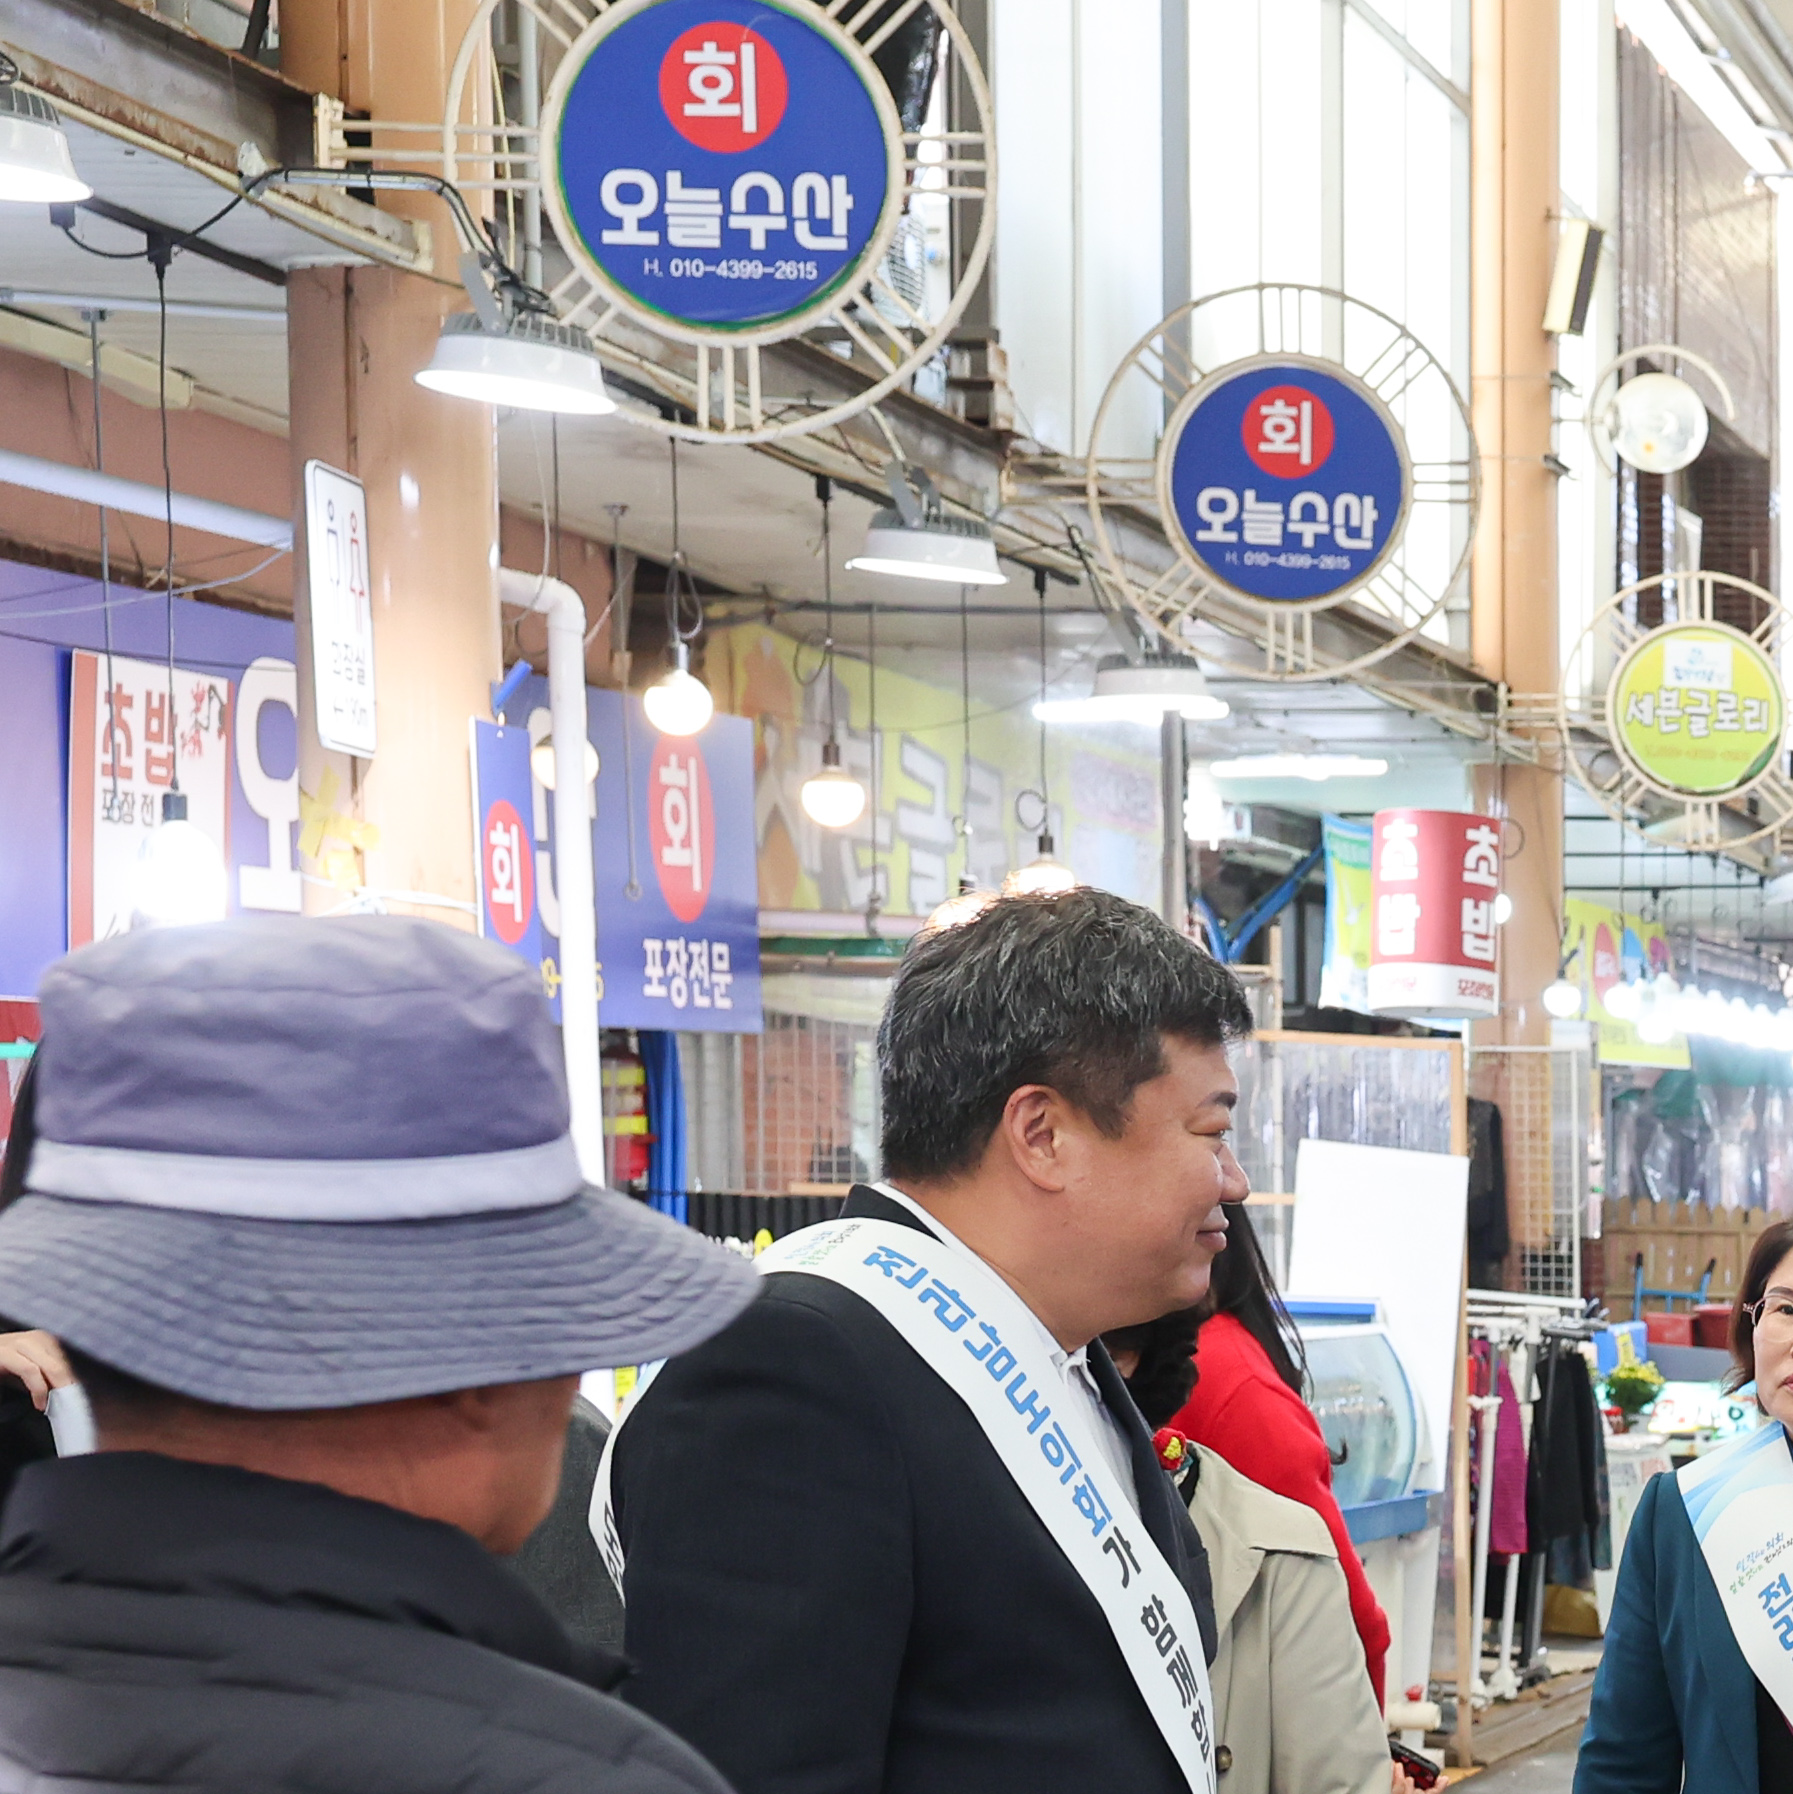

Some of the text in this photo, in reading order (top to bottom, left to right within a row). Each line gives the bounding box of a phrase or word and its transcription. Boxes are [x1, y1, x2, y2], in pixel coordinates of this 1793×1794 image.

[684, 41, 758, 134] 회
[600, 169, 854, 252] 오늘수산
[669, 259, 818, 281] 010-4399-2615
[1258, 399, 1313, 466] 회
[1196, 486, 1379, 551] 오늘수산
[1243, 550, 1351, 571] 010-4399-2615
[102, 682, 177, 786] 초밥
[1626, 685, 1770, 738] 세븐글로리
[659, 753, 702, 892] 회
[490, 821, 523, 923] 회
[1378, 818, 1421, 956] 초밥
[642, 936, 734, 1010] 포장전문
[862, 1245, 1142, 1589] 전라남도의회가
